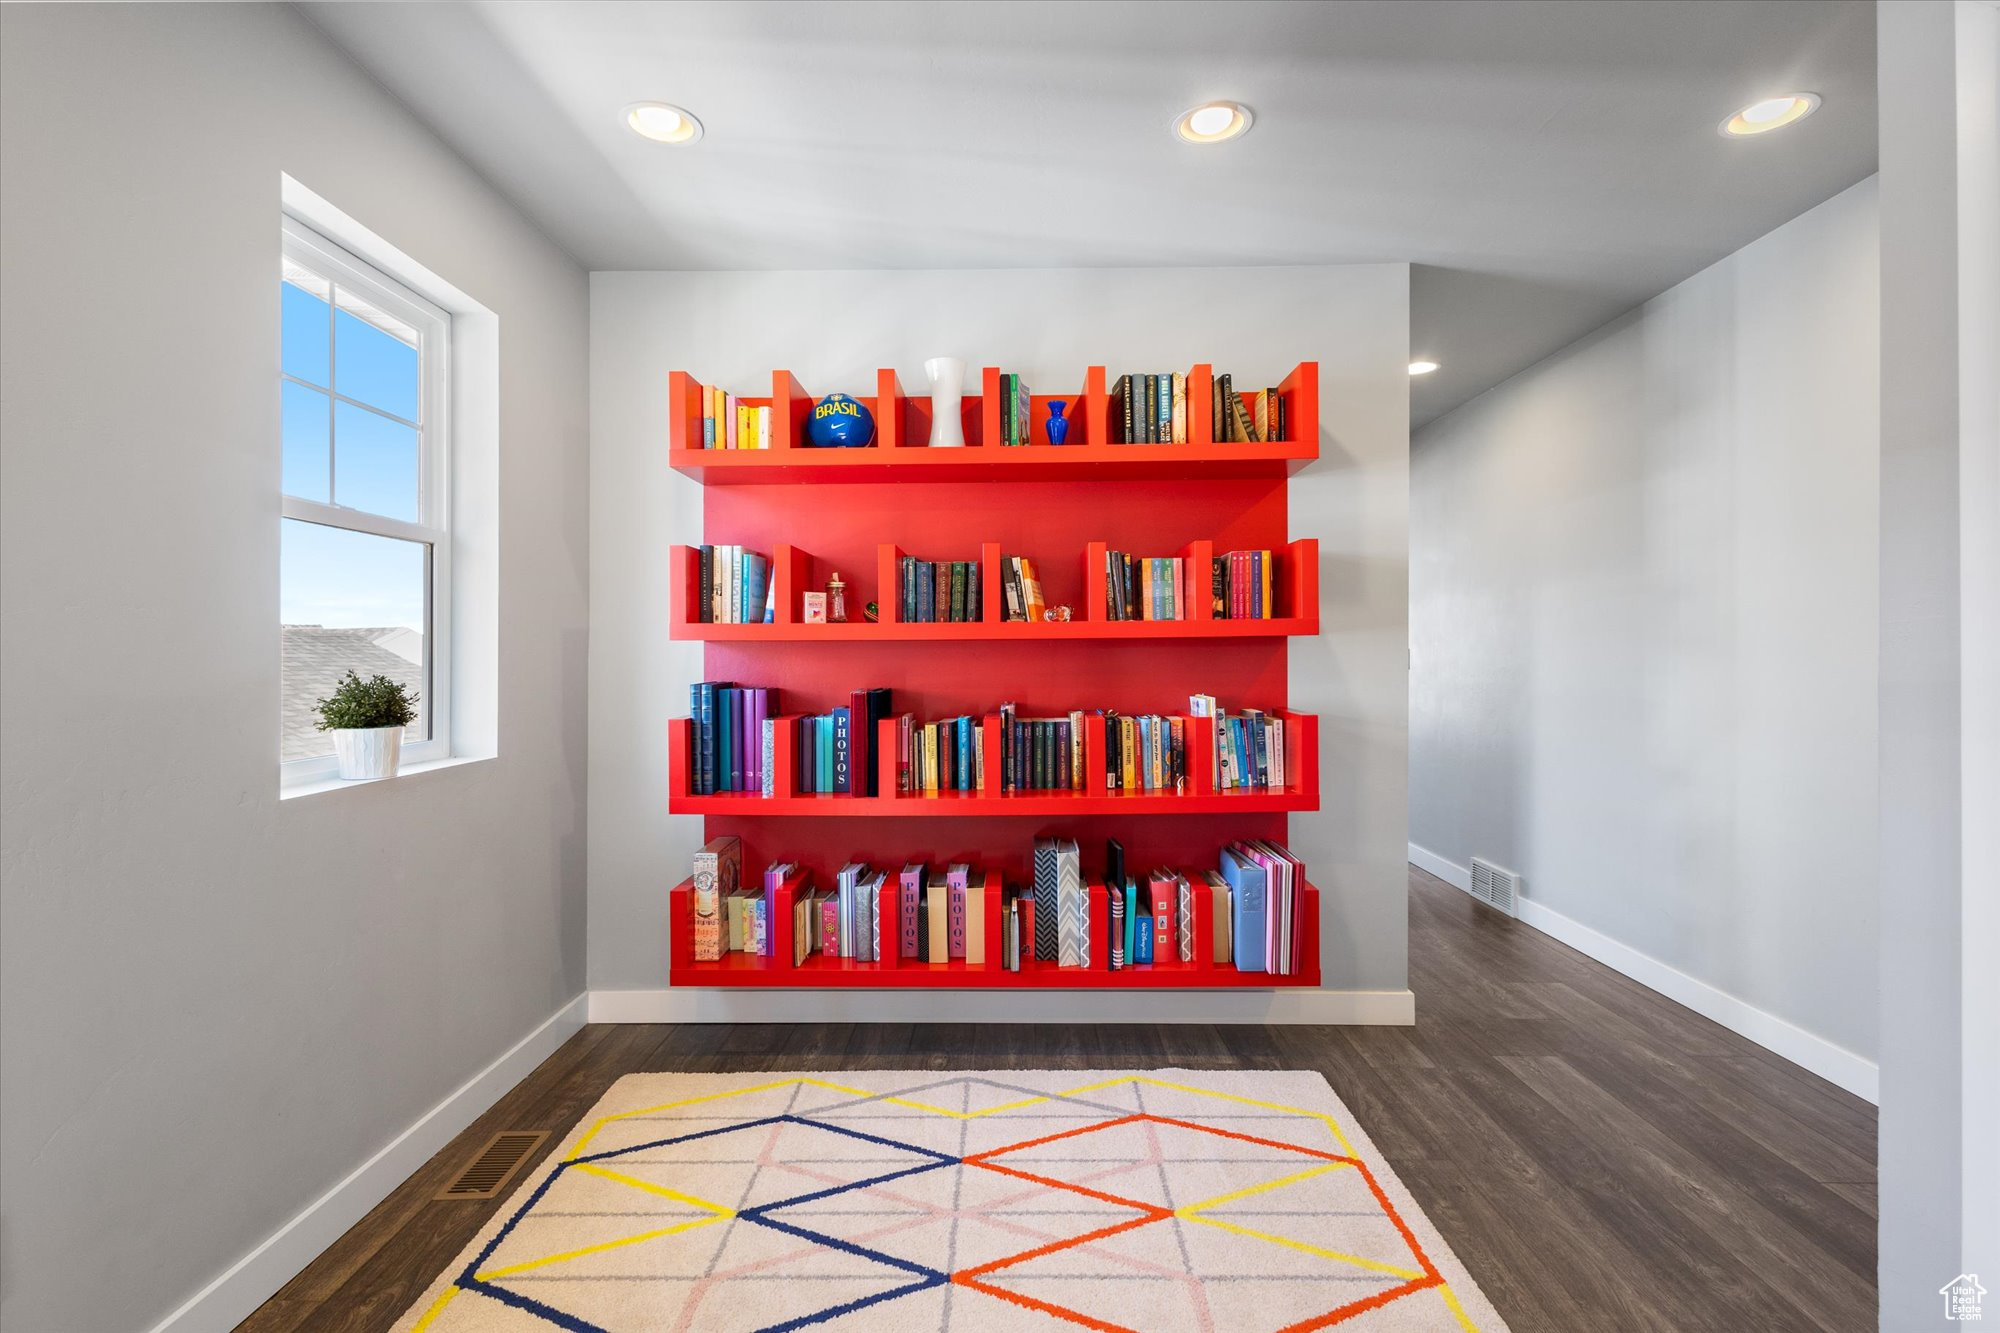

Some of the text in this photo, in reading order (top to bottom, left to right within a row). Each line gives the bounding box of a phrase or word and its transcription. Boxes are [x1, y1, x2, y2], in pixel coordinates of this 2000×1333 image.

[816, 401, 861, 419] BRASIL
[837, 716, 847, 784] PHOTOS
[906, 882, 914, 948] PHOTOS
[953, 882, 962, 948] PHOTOS
